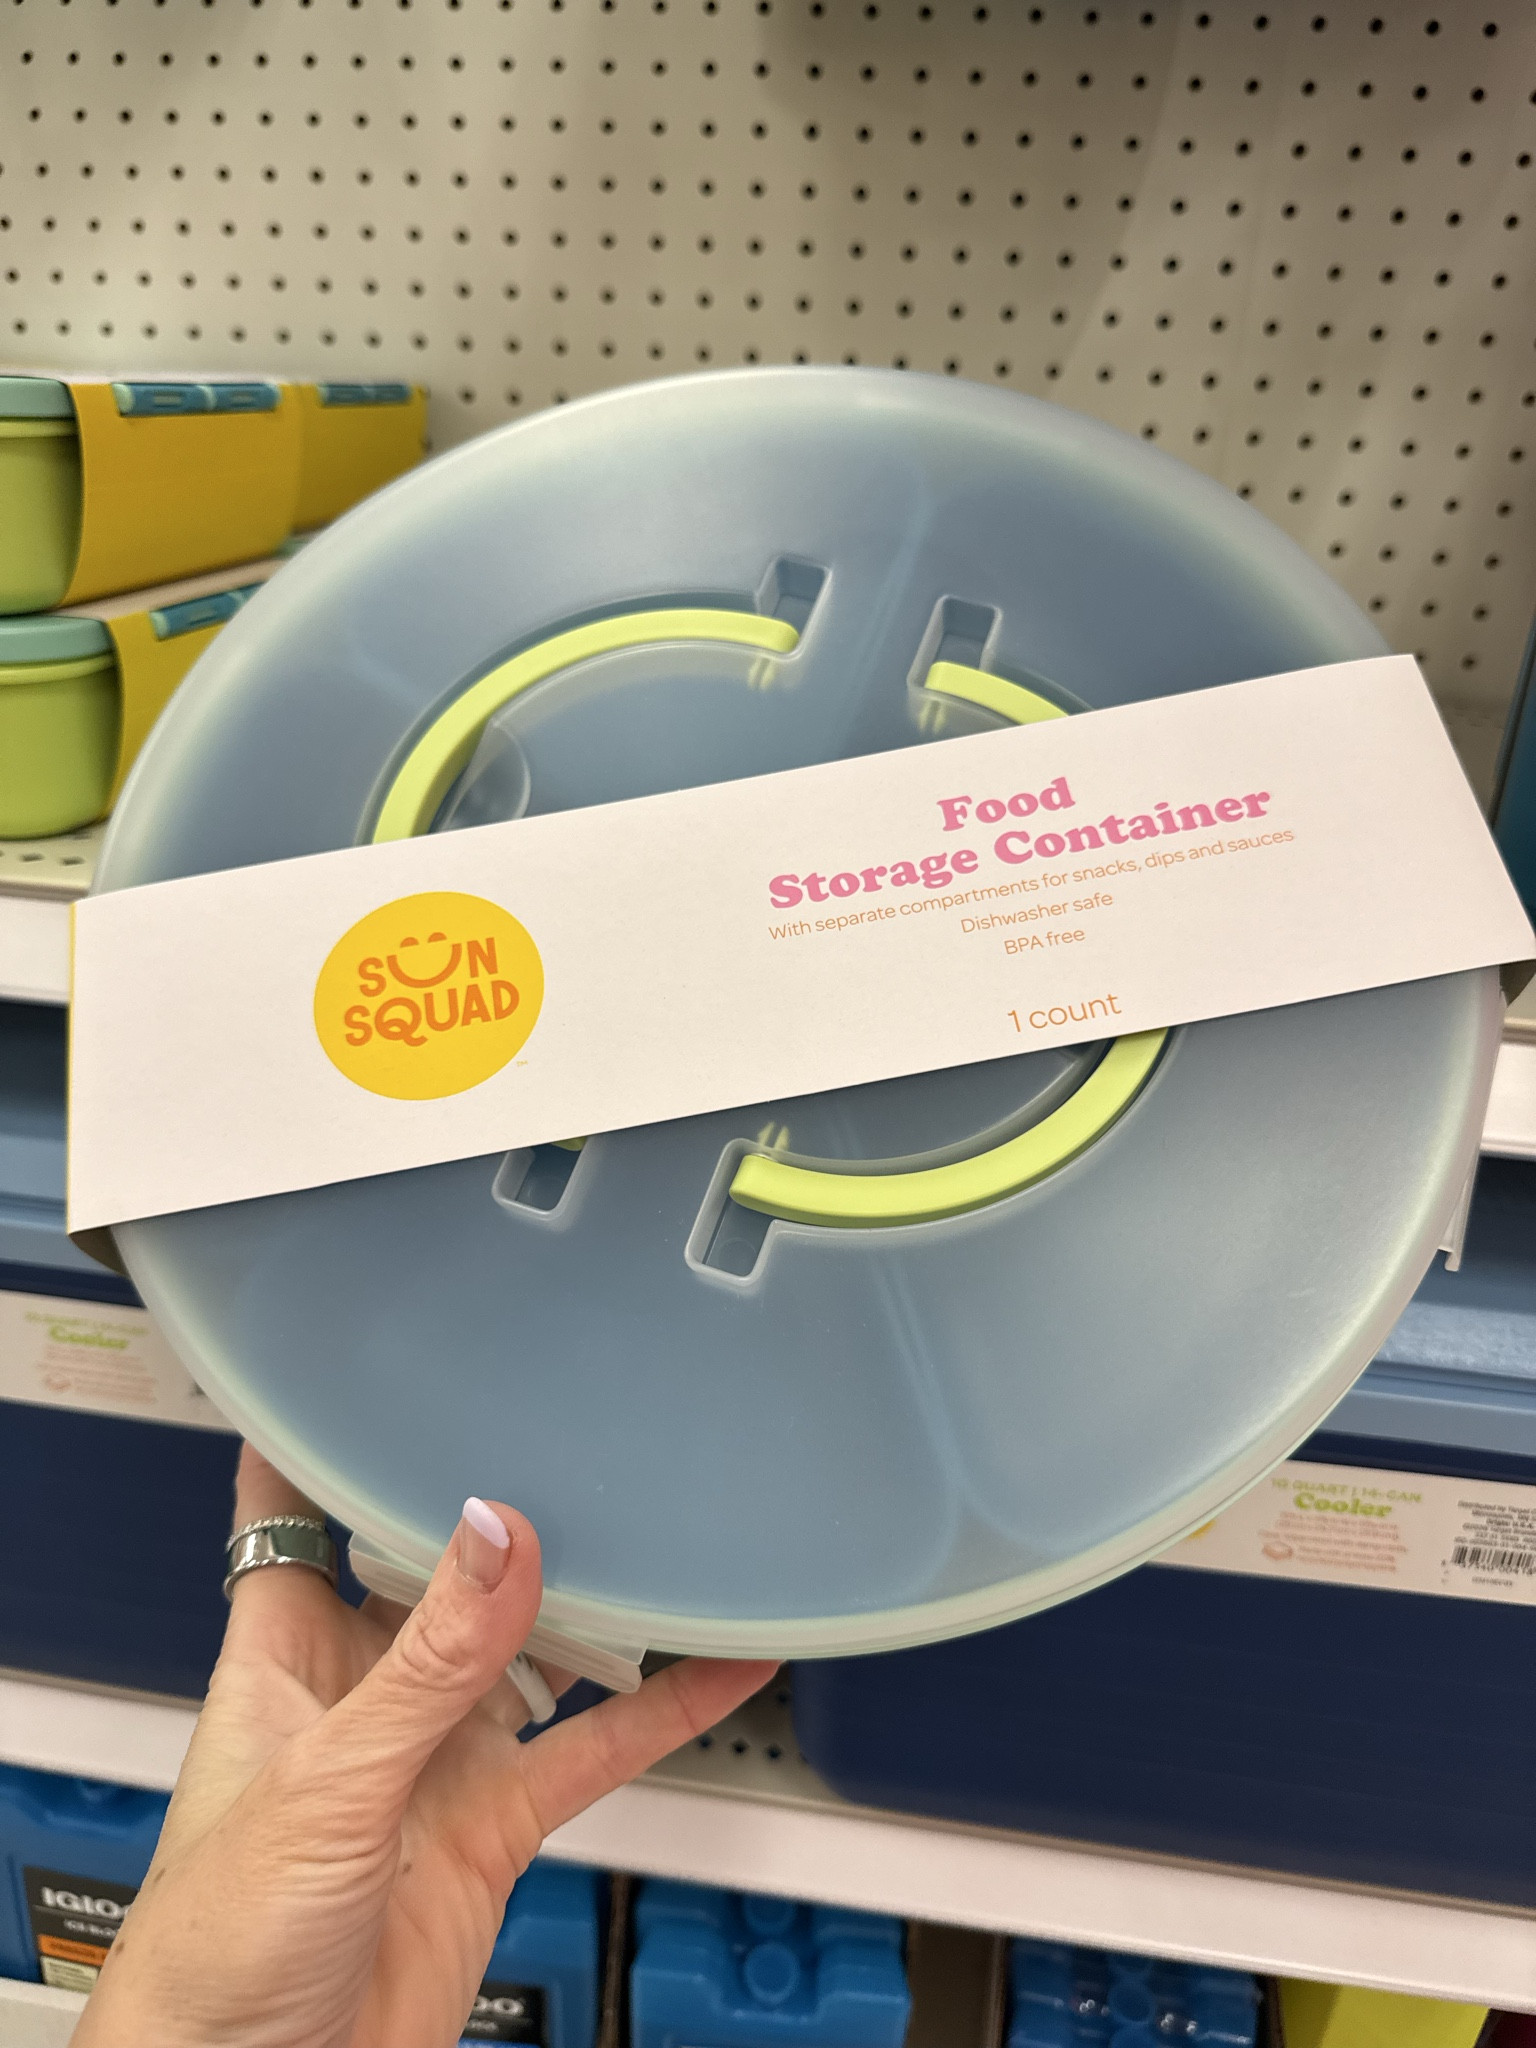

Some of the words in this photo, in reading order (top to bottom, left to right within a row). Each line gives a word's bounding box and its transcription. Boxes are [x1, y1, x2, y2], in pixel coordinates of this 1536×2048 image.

[937, 776, 1076, 832] Food
[768, 848, 980, 910] Storage
[994, 790, 1272, 865] Container
[768, 921, 812, 941] With
[815, 906, 897, 932] separate
[899, 878, 1040, 915] compartments
[1041, 873, 1069, 889] for
[1072, 859, 1143, 883] snacks,
[1144, 851, 1186, 869] dips
[1188, 840, 1226, 860] and
[1227, 828, 1296, 853] sauces
[960, 903, 1069, 934] Dishwasher
[1072, 892, 1114, 912] safe
[357, 935, 499, 998] SUN
[1004, 935, 1045, 955] BPA
[1045, 929, 1086, 947] free
[343, 979, 521, 1048] SQUAD
[1007, 1009, 1022, 1033] 1
[1028, 993, 1123, 1030] count
[1293, 1491, 1393, 1518] Cooler
